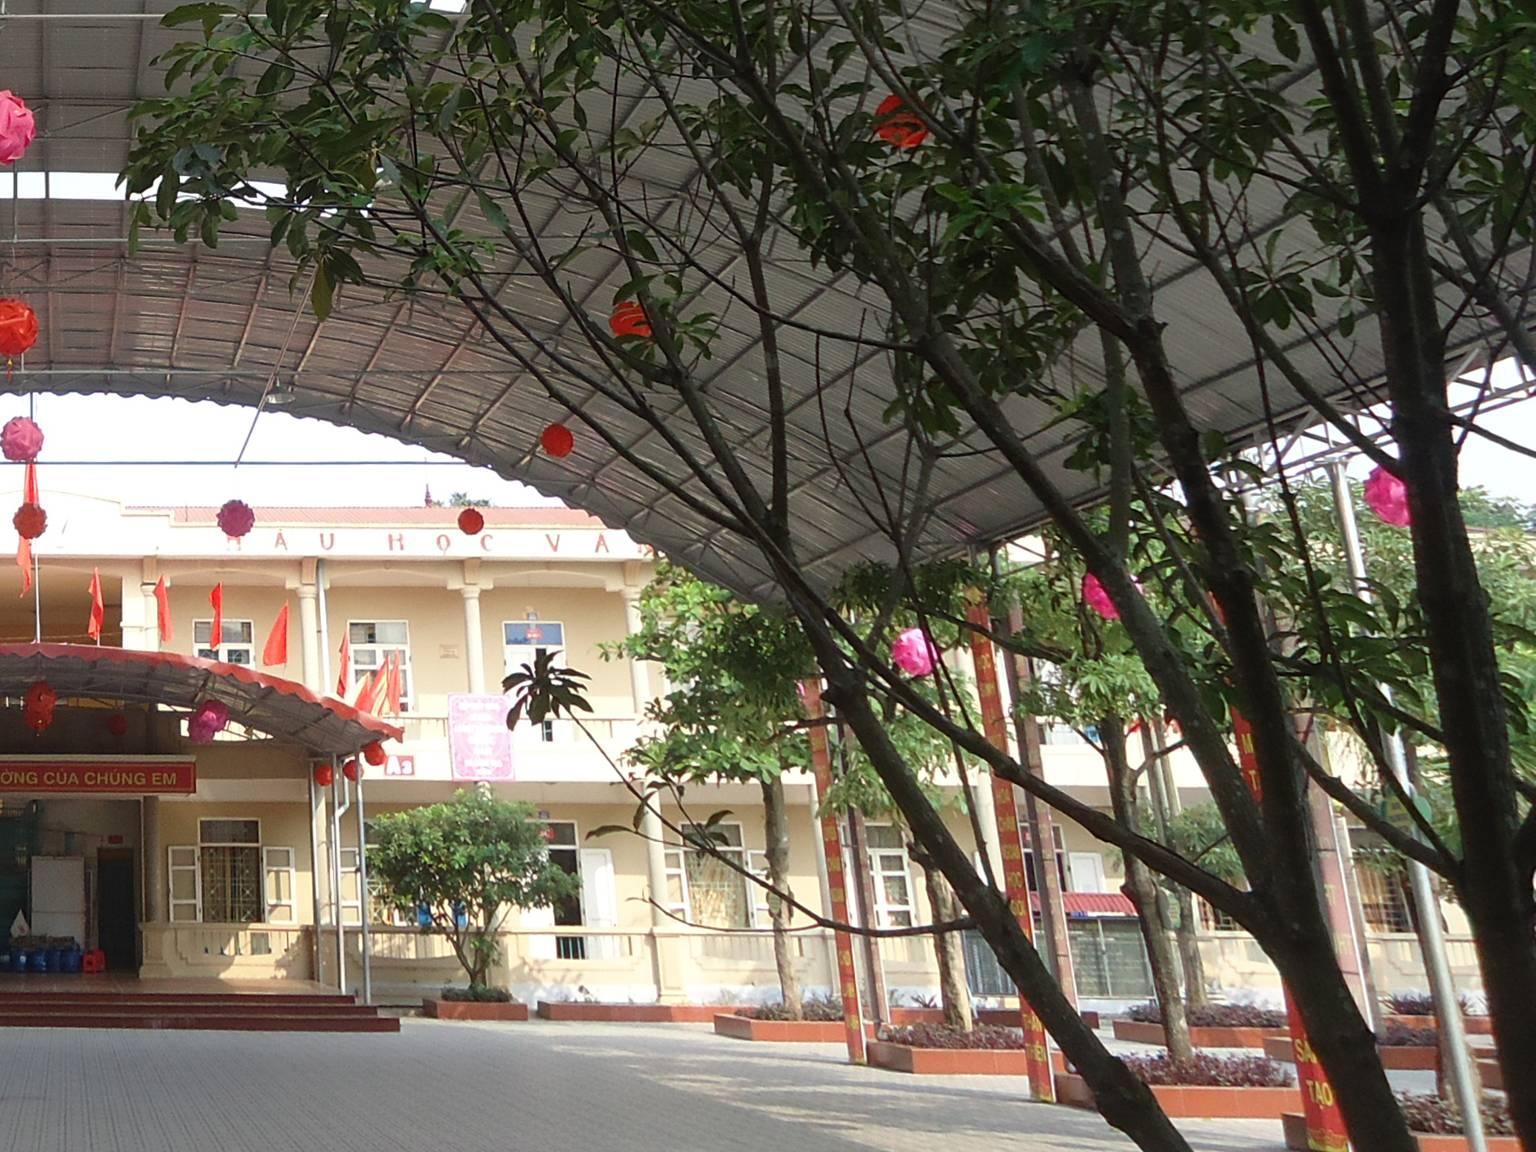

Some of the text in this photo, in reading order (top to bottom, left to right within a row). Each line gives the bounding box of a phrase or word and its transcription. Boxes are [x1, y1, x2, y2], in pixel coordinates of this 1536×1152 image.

[44, 768, 79, 785] CỦA
[84, 768, 146, 785] CHÚNG
[152, 772, 176, 785] EM
[1306, 1080, 1334, 1110] TẠO
